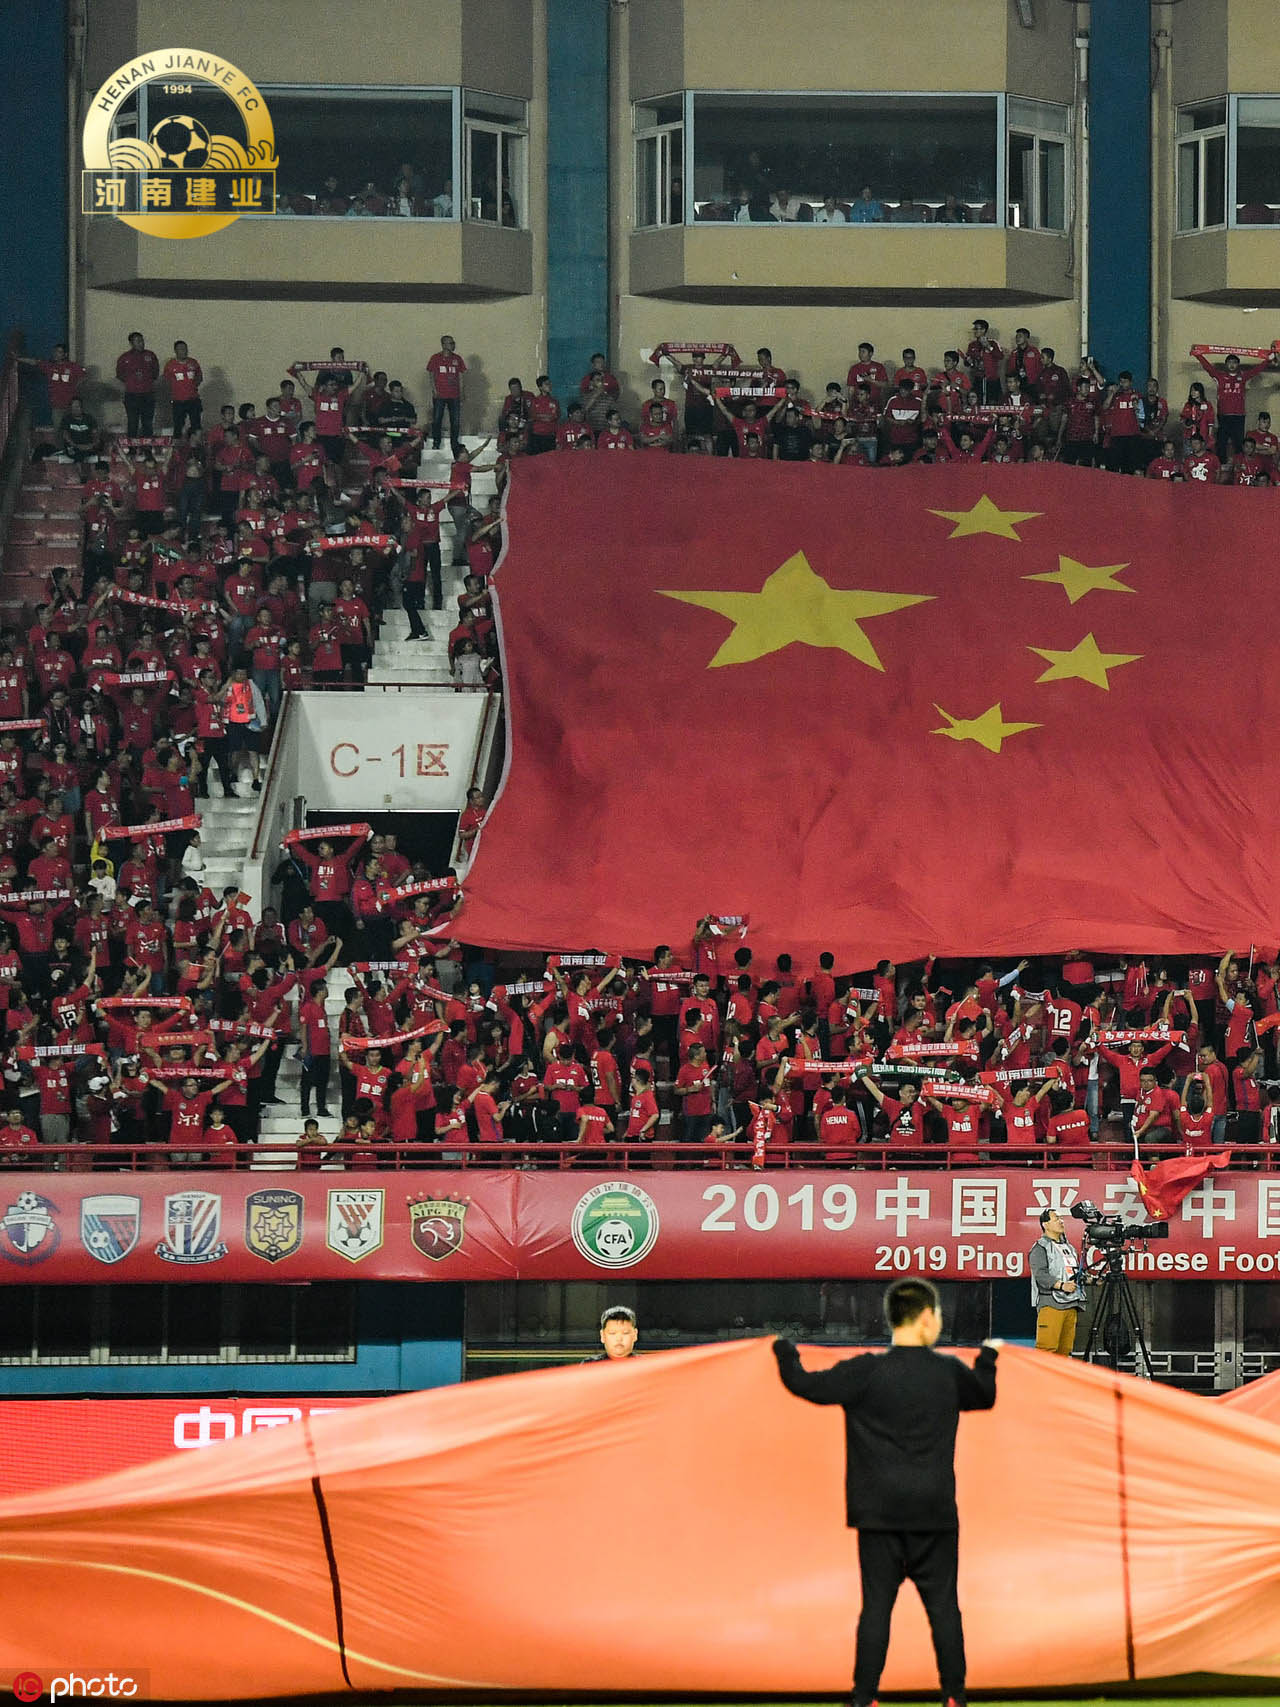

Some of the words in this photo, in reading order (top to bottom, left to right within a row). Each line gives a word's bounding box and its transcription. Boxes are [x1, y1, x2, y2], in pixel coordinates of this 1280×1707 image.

[330, 742, 450, 778] C-1区
[1052, 1008, 1072, 1030] 12
[825, 1115, 848, 1125] HENAN
[253, 1195, 297, 1204] SUNING
[335, 1194, 377, 1203] LNTS
[604, 1234, 627, 1244] CFA
[874, 1245, 947, 1271] 2019
[957, 1244, 1024, 1277] Ping
[1086, 1244, 1208, 1272] Cinese
